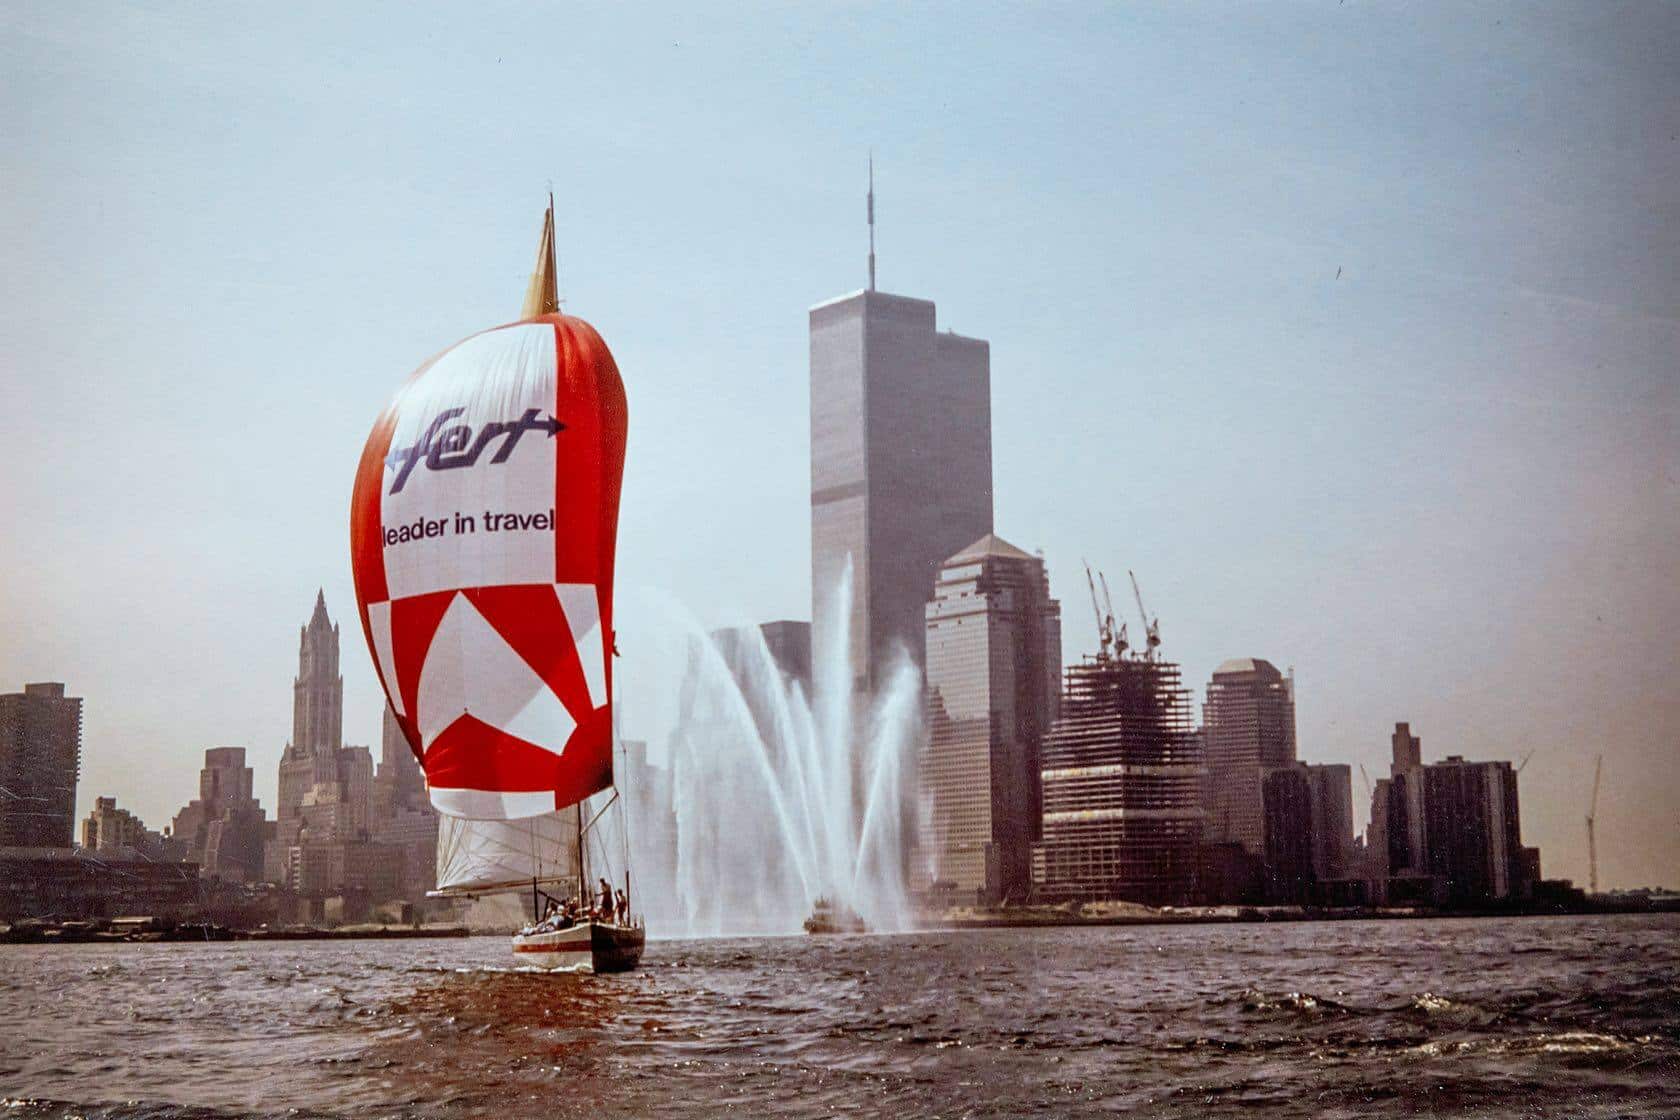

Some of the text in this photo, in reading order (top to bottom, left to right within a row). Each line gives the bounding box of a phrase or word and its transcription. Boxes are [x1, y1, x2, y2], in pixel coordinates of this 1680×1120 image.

[382, 509, 555, 547] leader in travel
